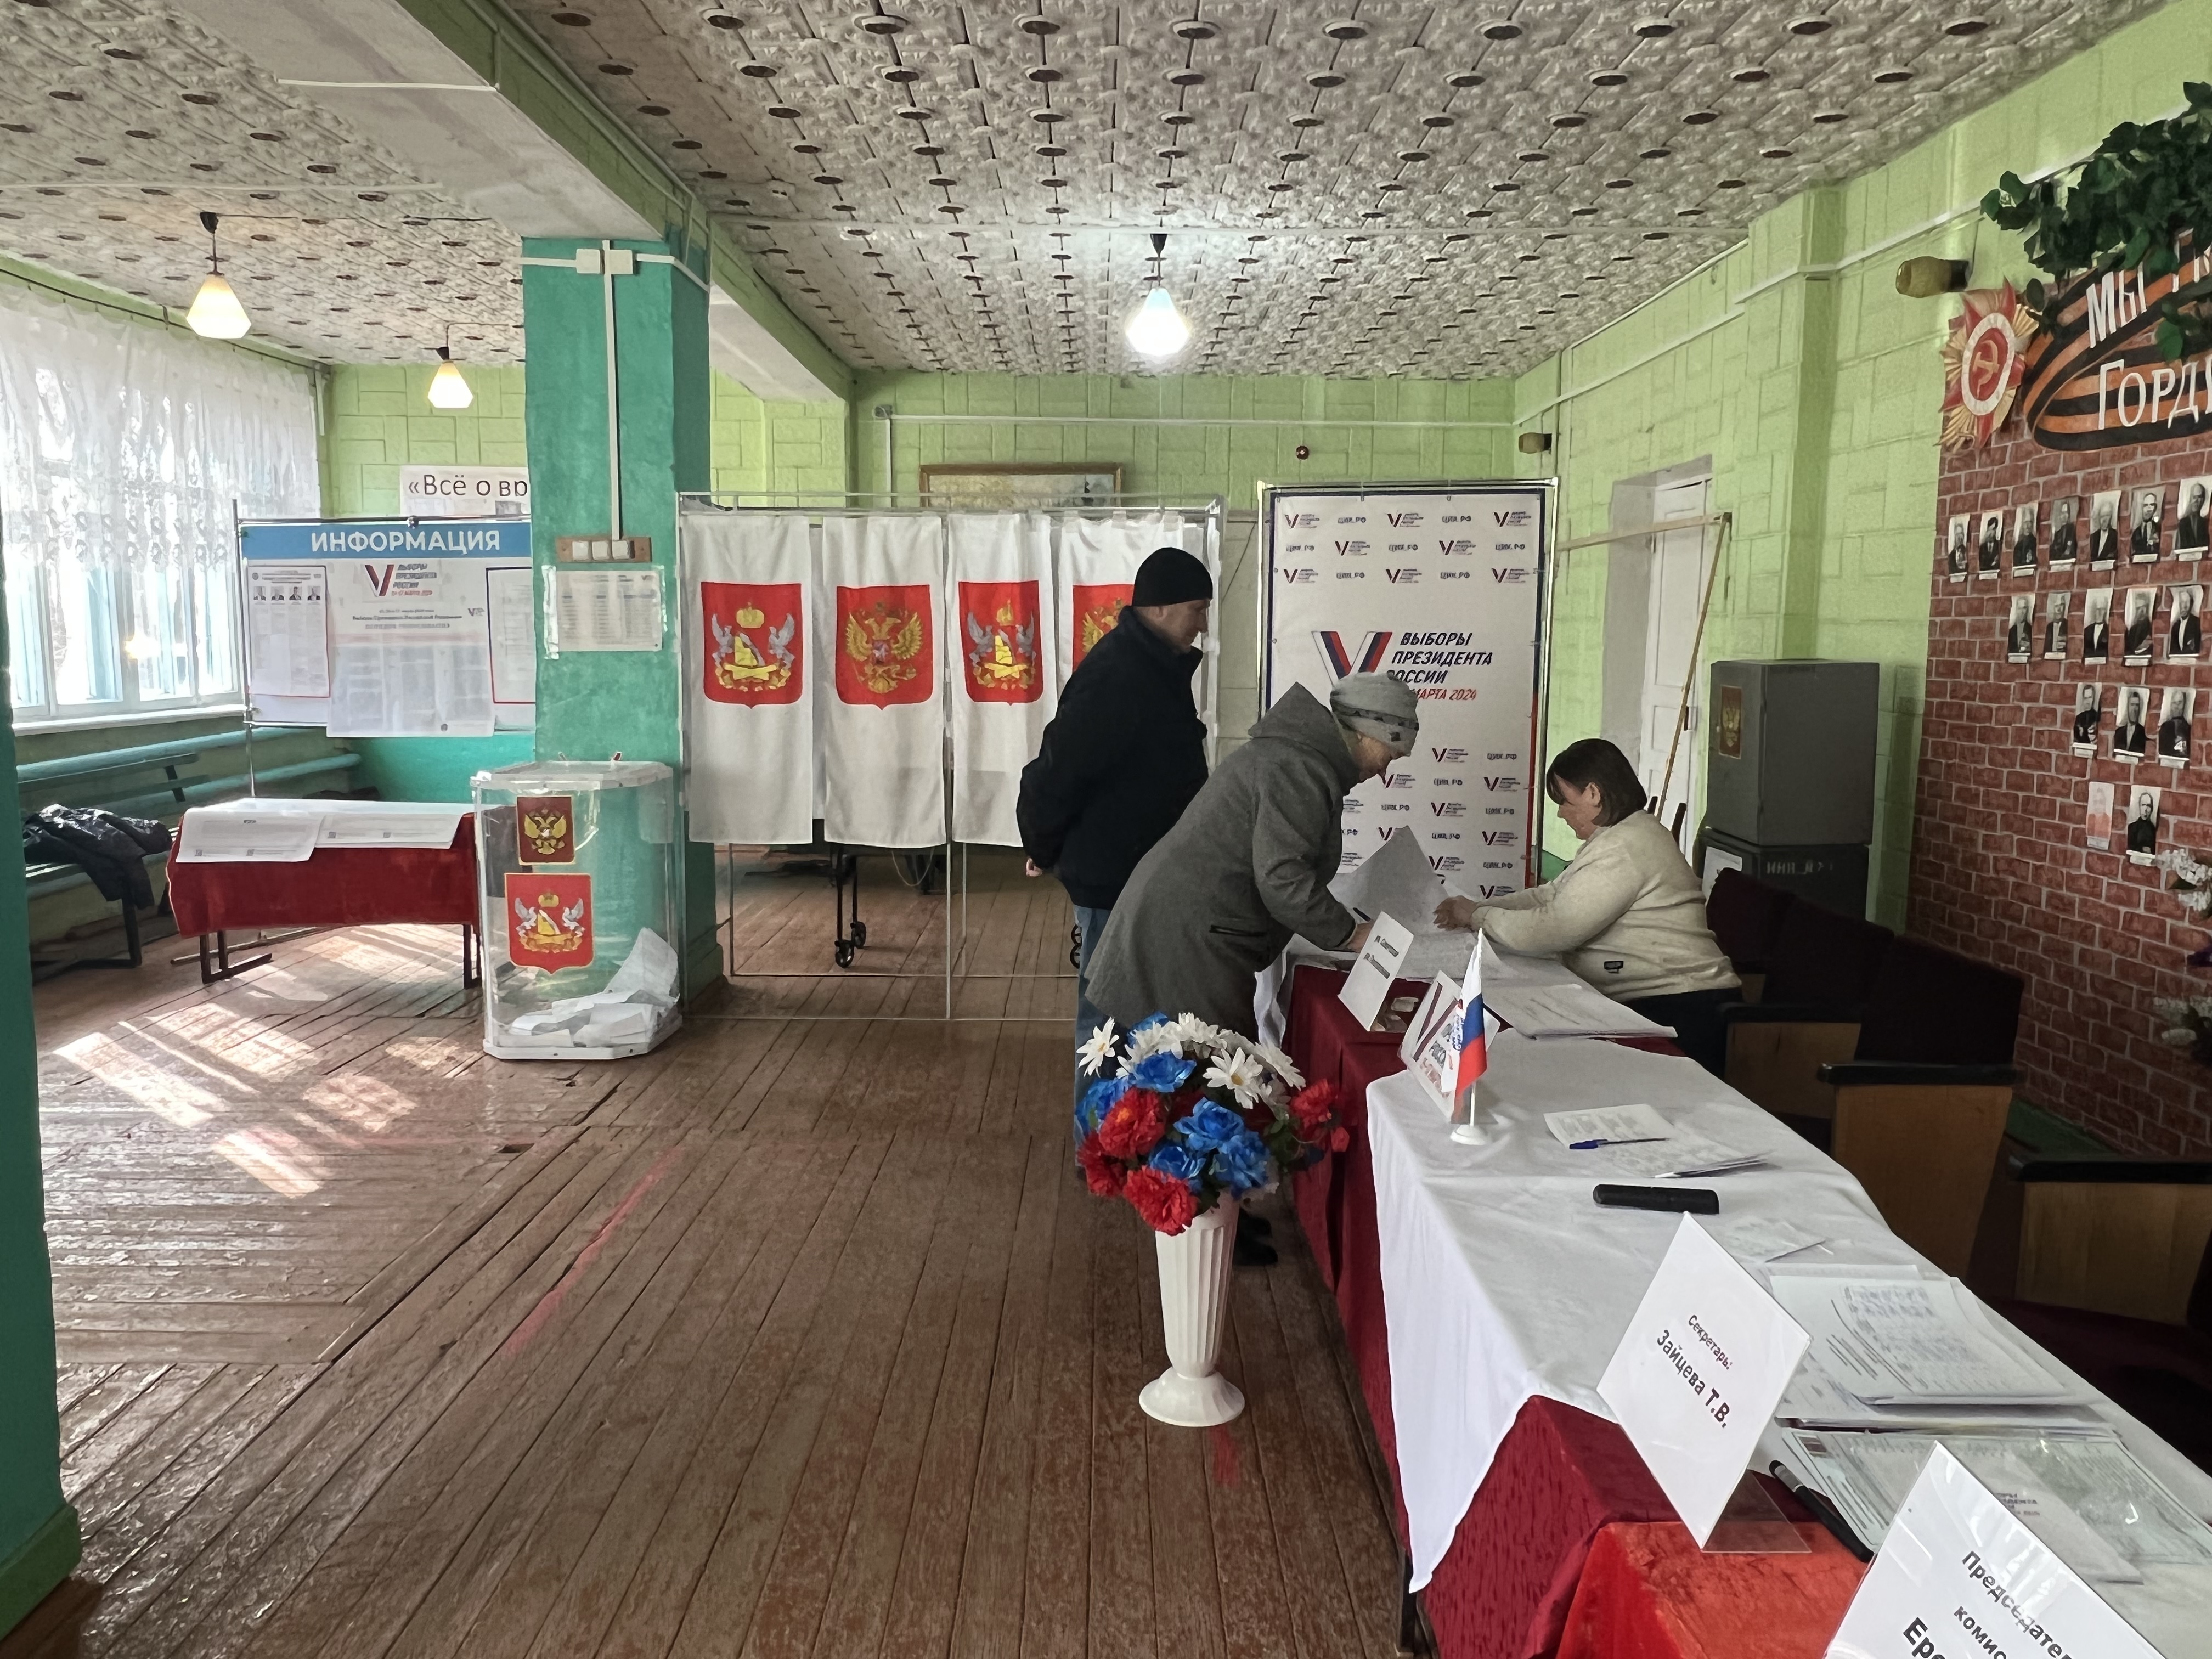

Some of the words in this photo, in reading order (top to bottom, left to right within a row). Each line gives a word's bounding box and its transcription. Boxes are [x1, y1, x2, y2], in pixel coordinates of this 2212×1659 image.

[408, 474, 466, 496] «Всё
[476, 479, 491, 496] о
[311, 530, 500, 555] ИНФОРМАЦИЯ
[1400, 632, 1473, 646] ВЫБОРЫ
[1391, 651, 1493, 667] ПРЕЗИДЕНТА
[1449, 688, 1477, 701] 2024
[1689, 1314, 1733, 1370] Секретарь:
[1657, 1329, 1706, 1396] Зайцева
[1705, 1387, 1730, 1429] Т.В.
